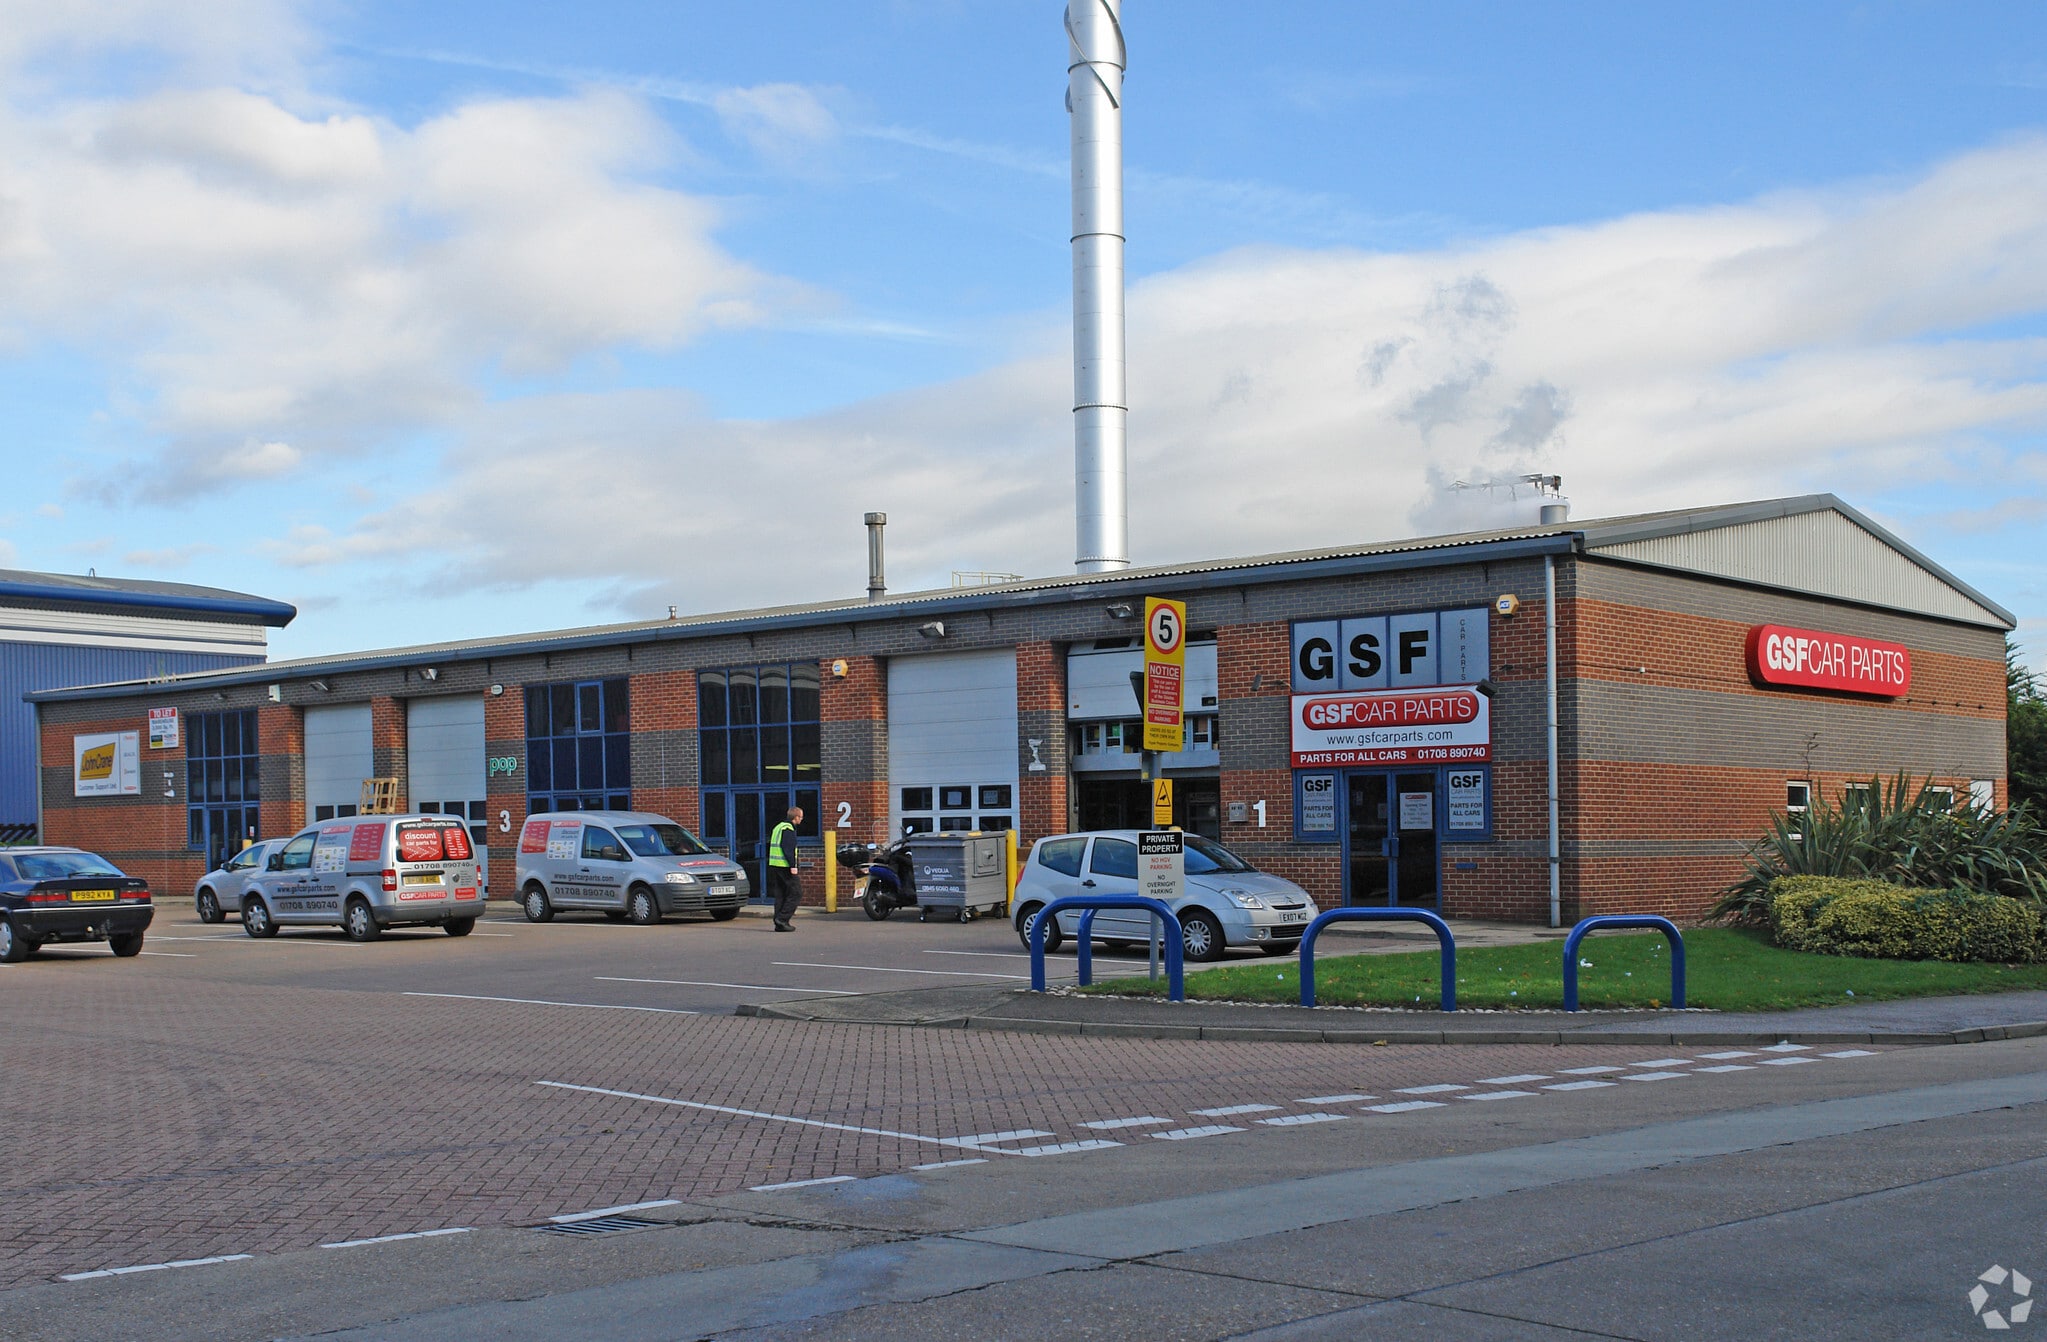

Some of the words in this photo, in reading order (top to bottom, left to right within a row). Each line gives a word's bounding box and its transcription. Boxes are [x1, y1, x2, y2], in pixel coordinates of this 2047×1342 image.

[1158, 614, 1173, 644] 5
[1149, 664, 1180, 678] NOTICE
[1851, 645, 1905, 685] PARTS
[153, 710, 160, 718] TO
[163, 709, 173, 717] LET
[1403, 696, 1472, 721] PARTS
[1326, 730, 1453, 747] www.gsfcarparts.com
[1300, 752, 1332, 764] PARTS
[1334, 752, 1354, 762] FOR
[1357, 750, 1376, 761] ALL
[1378, 749, 1407, 761] CARS
[1417, 748, 1448, 760] 01708
[1449, 747, 1486, 758] 890740
[489, 757, 517, 777] pop
[1304, 779, 1332, 792] GSF
[1450, 775, 1482, 788] GSF
[836, 801, 852, 828] 2
[1252, 799, 1266, 828] 1
[499, 809, 511, 833] 3
[404, 832, 437, 840] discount
[1146, 834, 1175, 843] PRIVATE
[1141, 844, 1180, 854] PROPERTY
[554, 873, 615, 882] www.gsfcarparts.com
[75, 891, 95, 899] P992
[277, 885, 336, 895] www.gsfcarparts.com
[428, 890, 446, 898] PARTS
[554, 886, 581, 895] 01708
[582, 888, 615, 897] 890740
[280, 901, 303, 910] 01708
[306, 900, 338, 910] 890740
